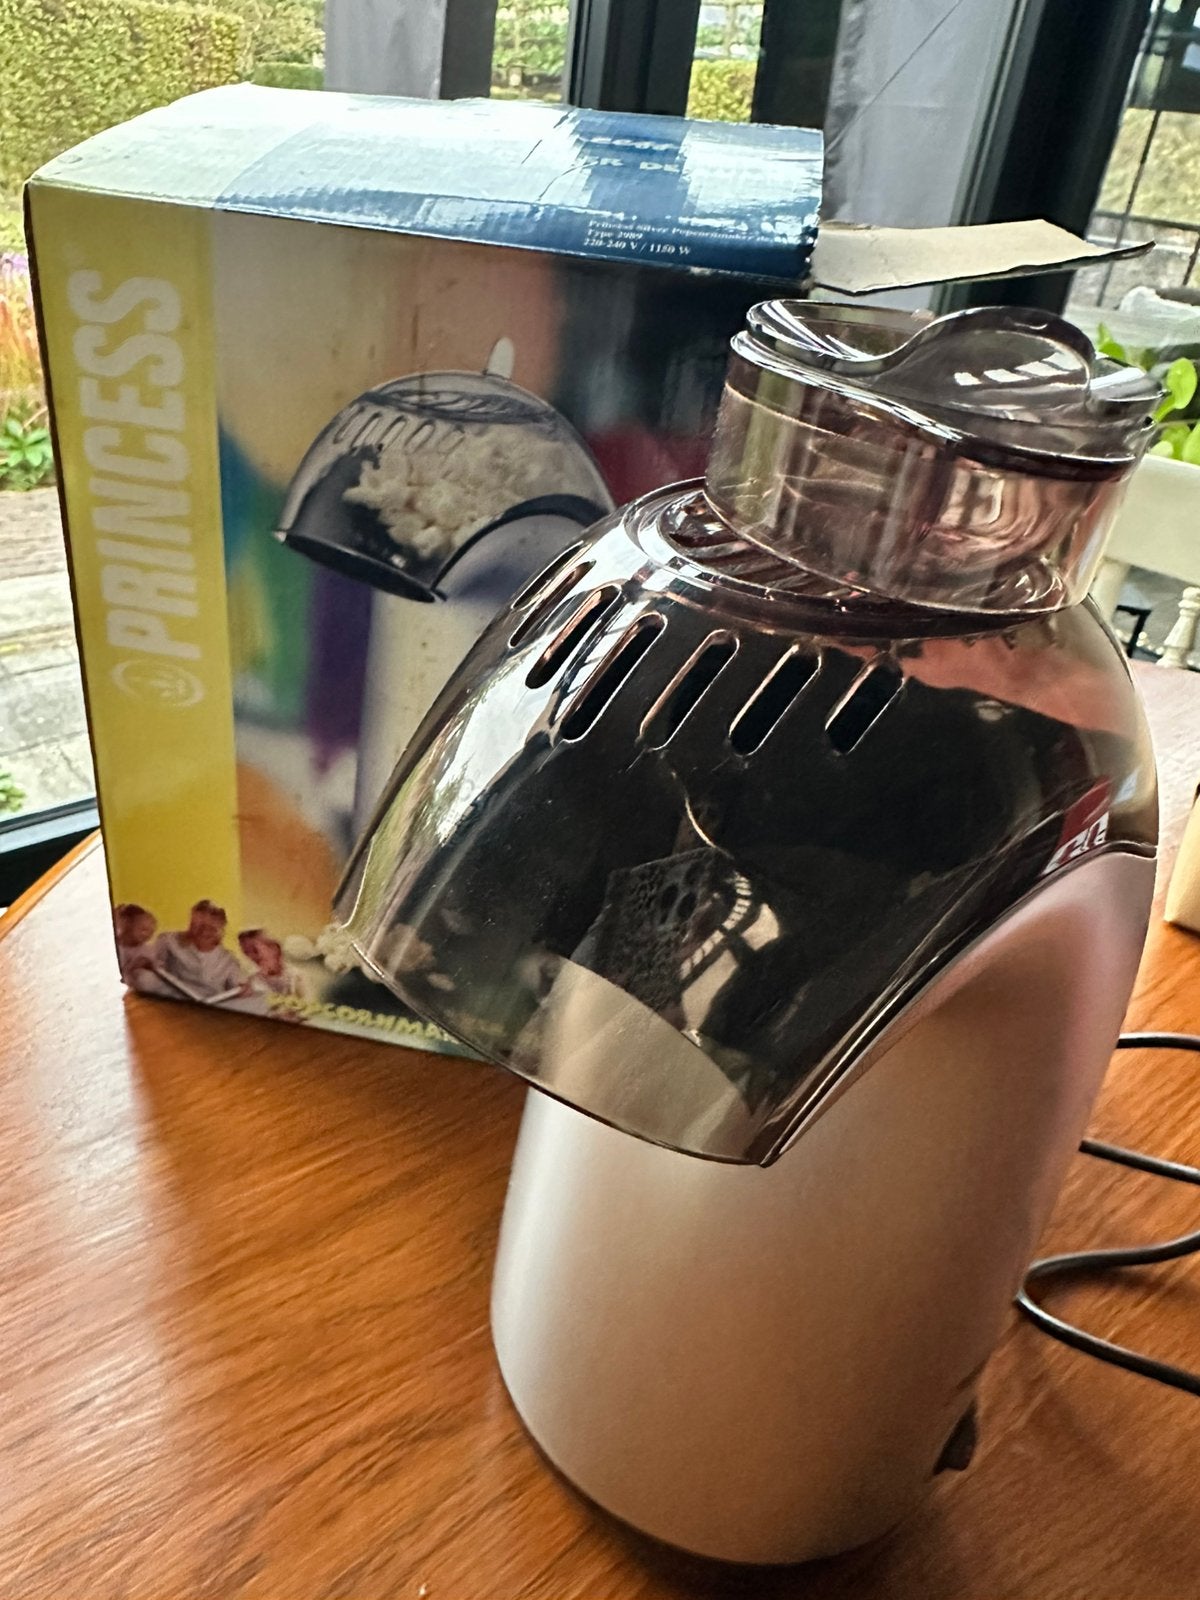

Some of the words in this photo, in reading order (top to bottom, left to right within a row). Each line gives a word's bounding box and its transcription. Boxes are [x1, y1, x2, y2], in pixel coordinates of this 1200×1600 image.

[587, 229, 613, 239] Type
[630, 241, 638, 250] V
[679, 245, 692, 256] W
[67, 268, 202, 661] PRINCESS
